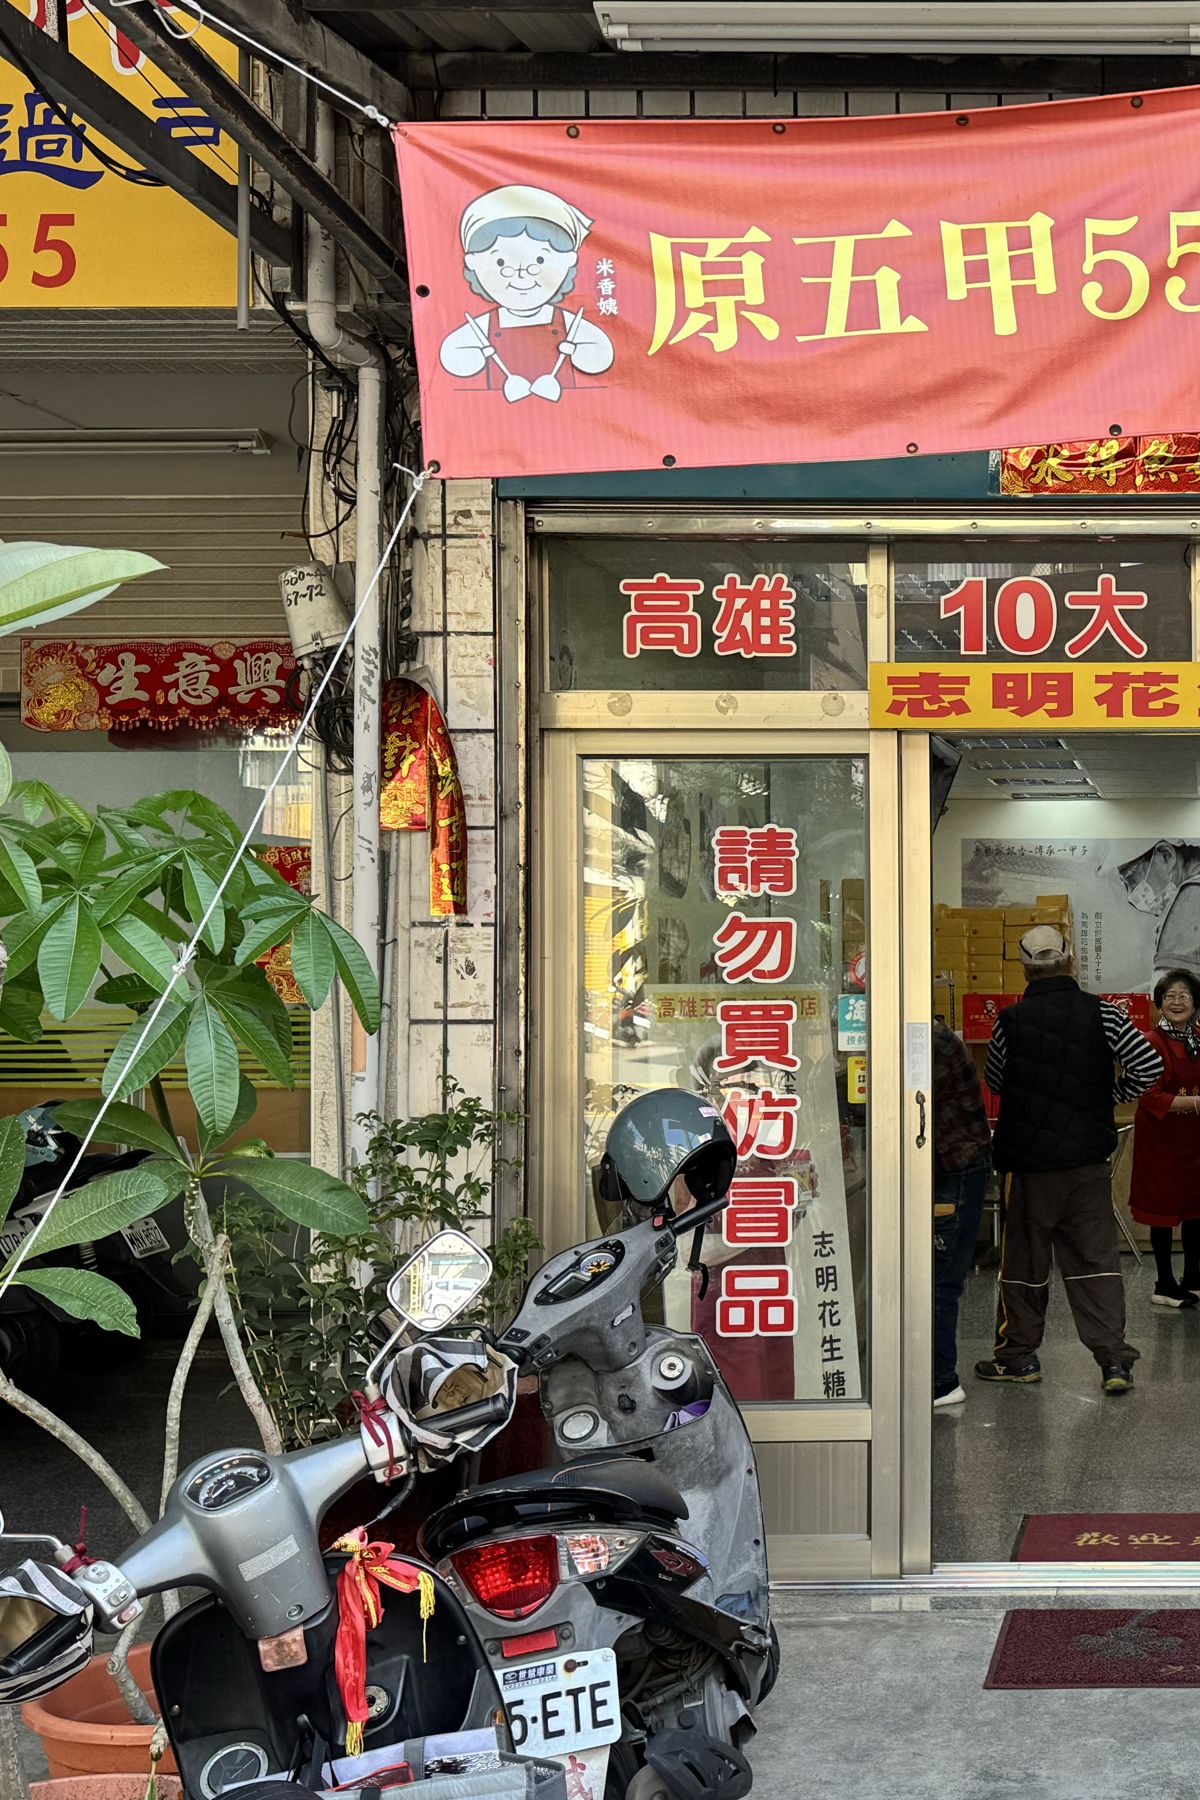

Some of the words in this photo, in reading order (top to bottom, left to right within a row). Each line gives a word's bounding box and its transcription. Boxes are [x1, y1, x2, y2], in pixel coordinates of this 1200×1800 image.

[0, 214, 77, 289] 5
[596, 257, 618, 316] 米香姨
[619, 572, 797, 658] 高雄
[940, 573, 1149, 659] 10大
[97, 651, 308, 706] 生意興
[712, 824, 800, 1337] 請勿買仿冒品
[812, 1230, 846, 1398] 志明花生糖
